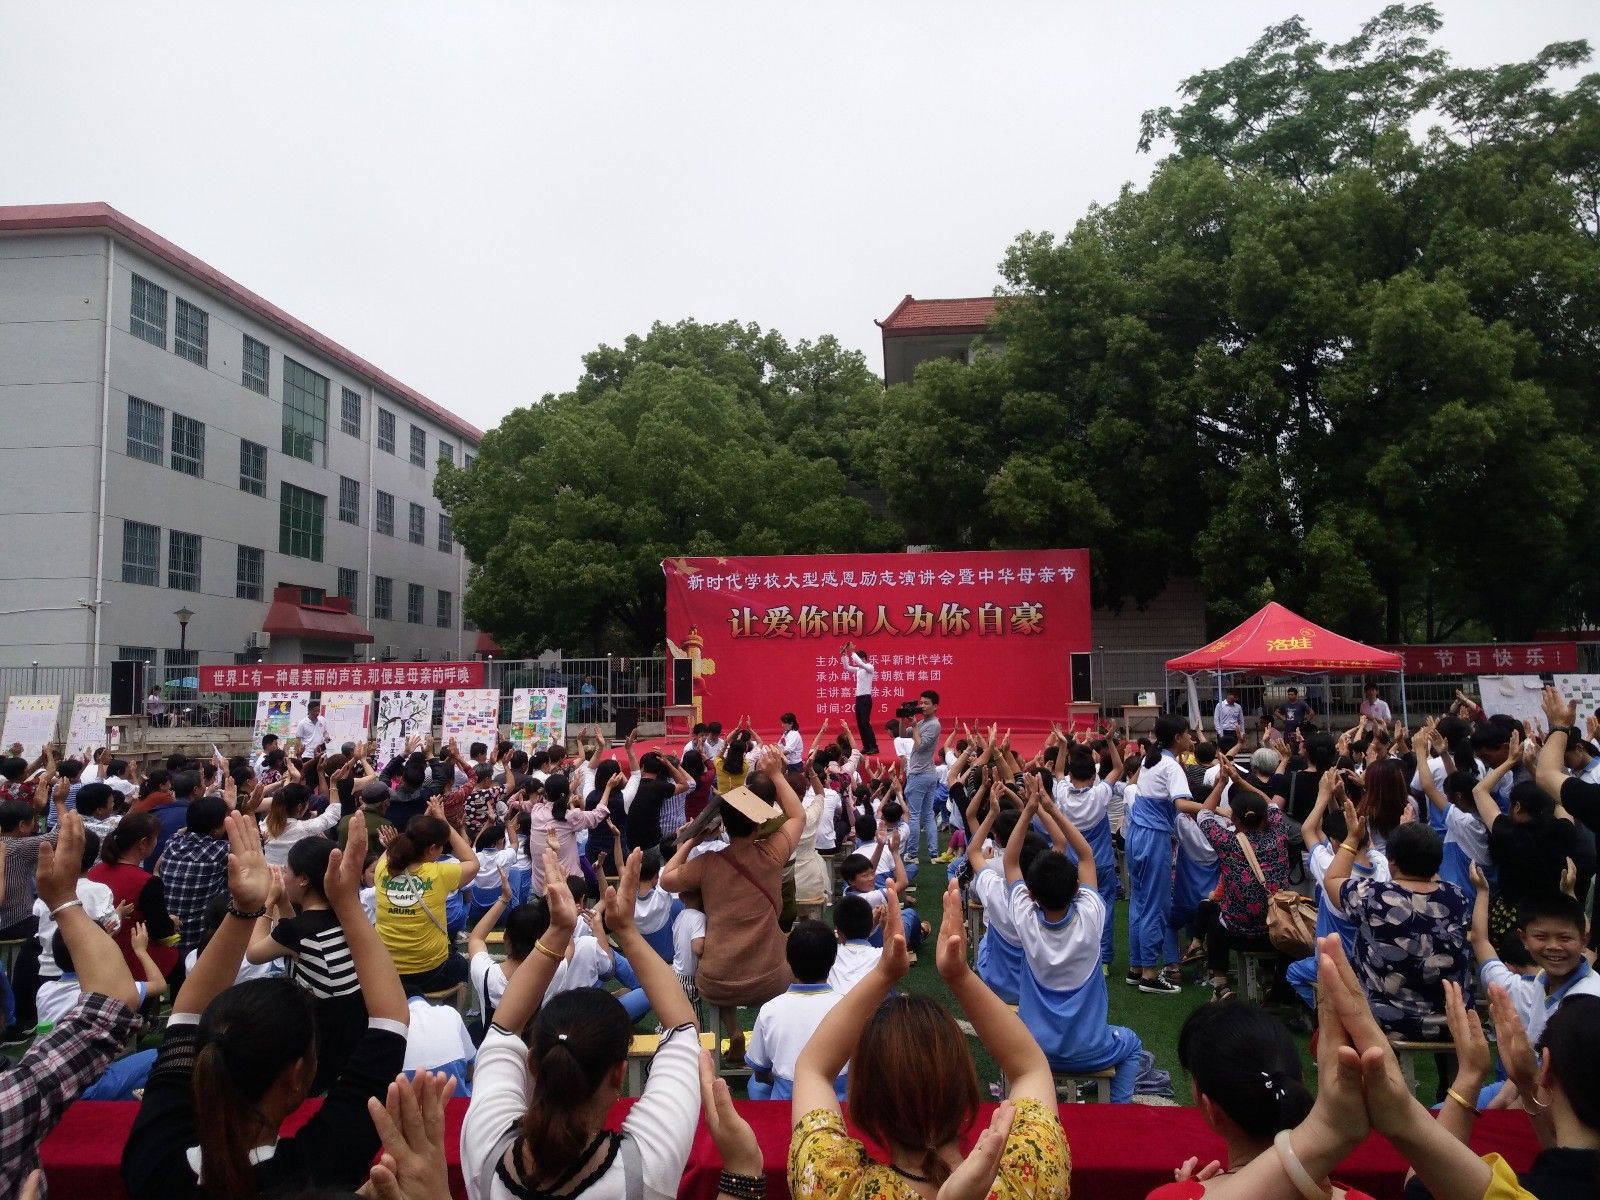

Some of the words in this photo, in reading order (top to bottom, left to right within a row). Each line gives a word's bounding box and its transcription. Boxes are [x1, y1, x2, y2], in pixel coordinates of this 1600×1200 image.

[687, 566, 1076, 591] 新时代学校大型感恩励志演讲会暨中华母亲节
[728, 601, 1044, 639] 让爱你的人为你自豪
[1265, 637, 1313, 652] 洛娃
